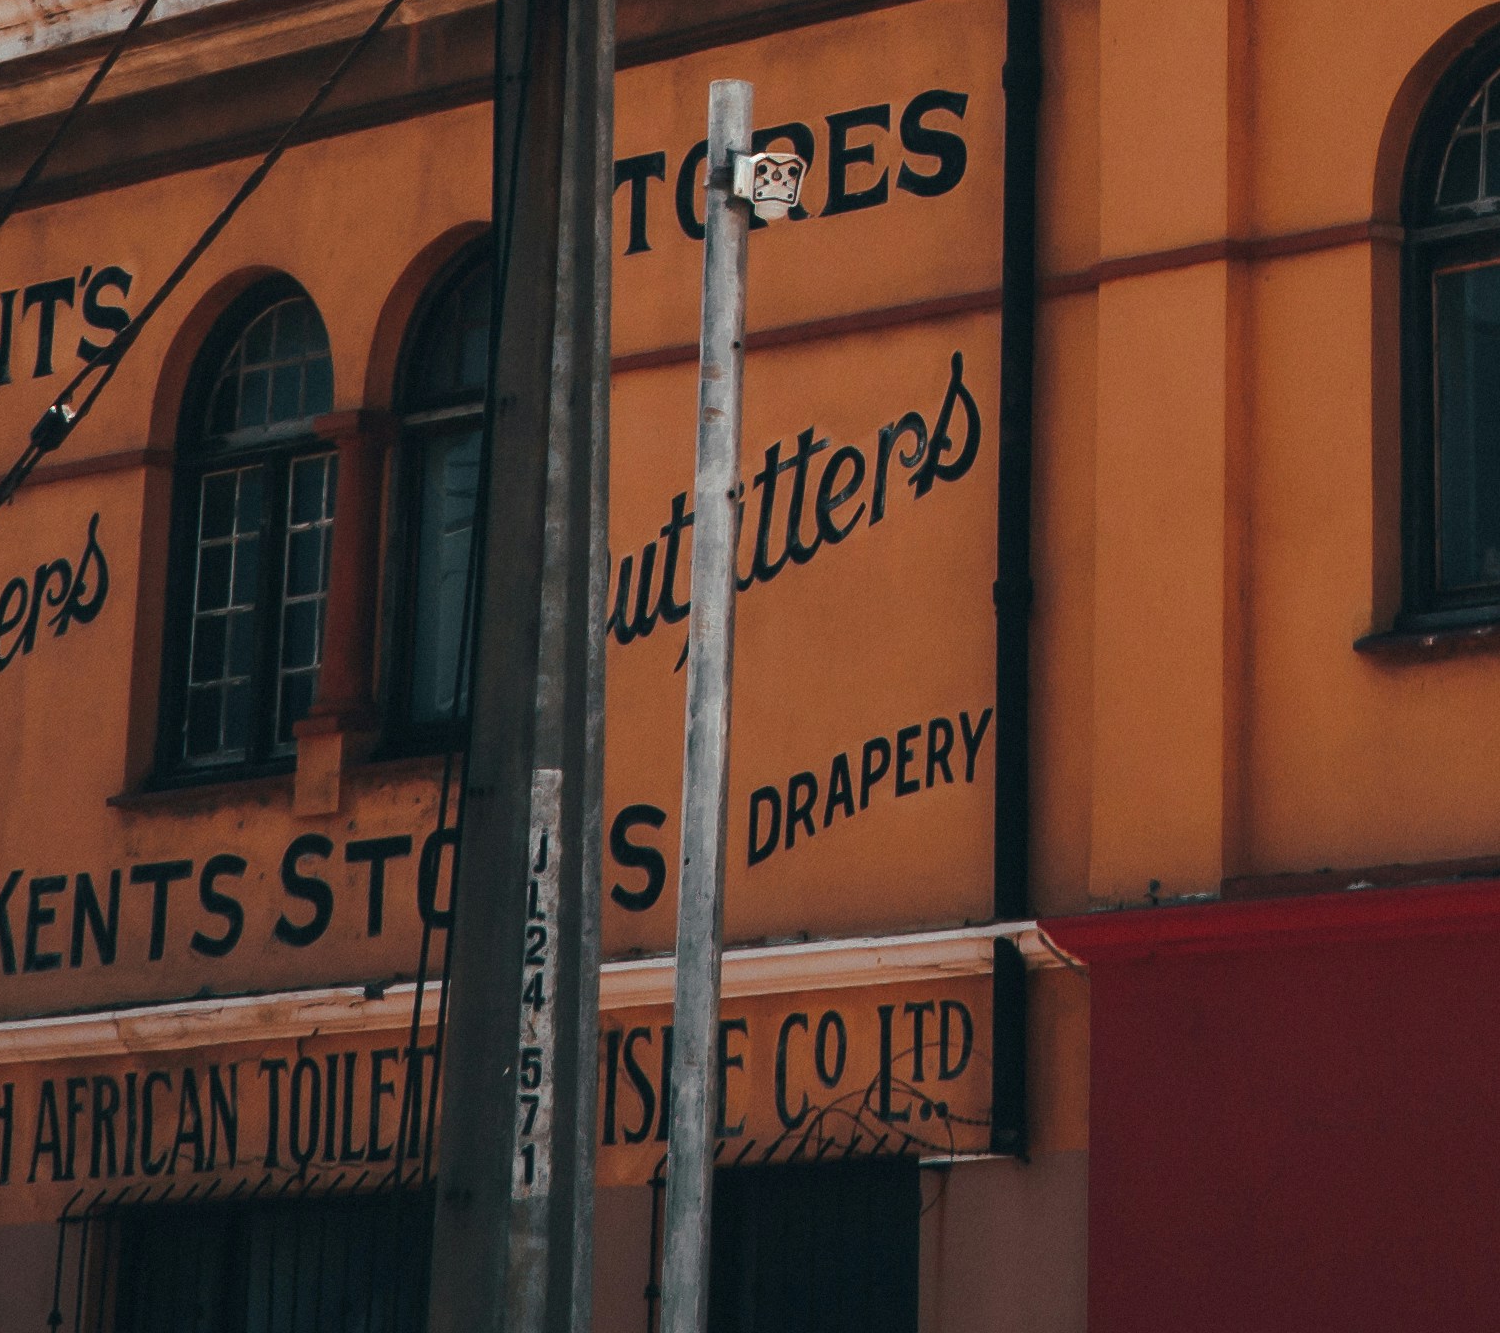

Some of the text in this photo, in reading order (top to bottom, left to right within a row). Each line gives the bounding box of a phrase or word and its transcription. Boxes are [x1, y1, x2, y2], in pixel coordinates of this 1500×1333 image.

[747, 708, 995, 868] DRAPERY
[27, 1062, 239, 1184] AFRICAN
[258, 1044, 437, 1168] TOILET
